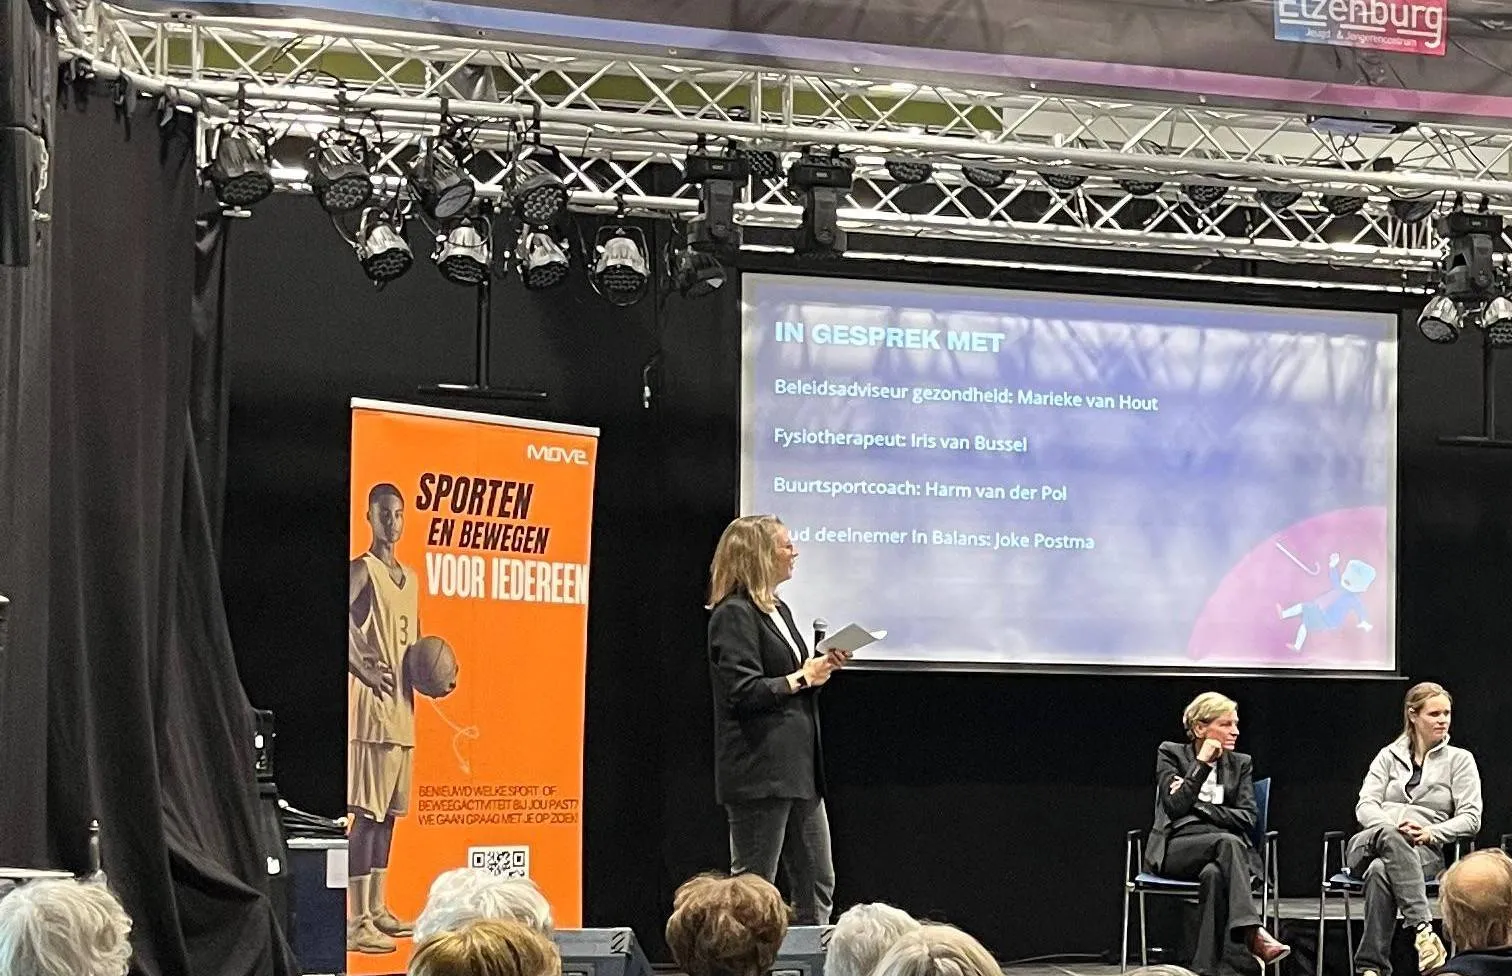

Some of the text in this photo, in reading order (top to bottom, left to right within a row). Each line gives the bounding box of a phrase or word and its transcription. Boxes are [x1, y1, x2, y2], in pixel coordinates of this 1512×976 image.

[775, 321, 1006, 353] IN GESPREK MET
[774, 378, 1159, 412] Beleidsadviseur gezondheid: Marieke van Hout
[773, 428, 1028, 452] Fysiotherapeut: Iris van Bussel
[415, 472, 534, 520] SPORTEN
[773, 476, 1067, 500] Buurtsportcoach: Harm van der Pol
[427, 517, 550, 555] EN BEWEGEN
[814, 526, 908, 545] deelnemer
[932, 530, 992, 547] Balans:
[994, 533, 1031, 550] Joke
[1034, 533, 1095, 549] Postma
[425, 551, 591, 606] VOOR IEDEREEN
